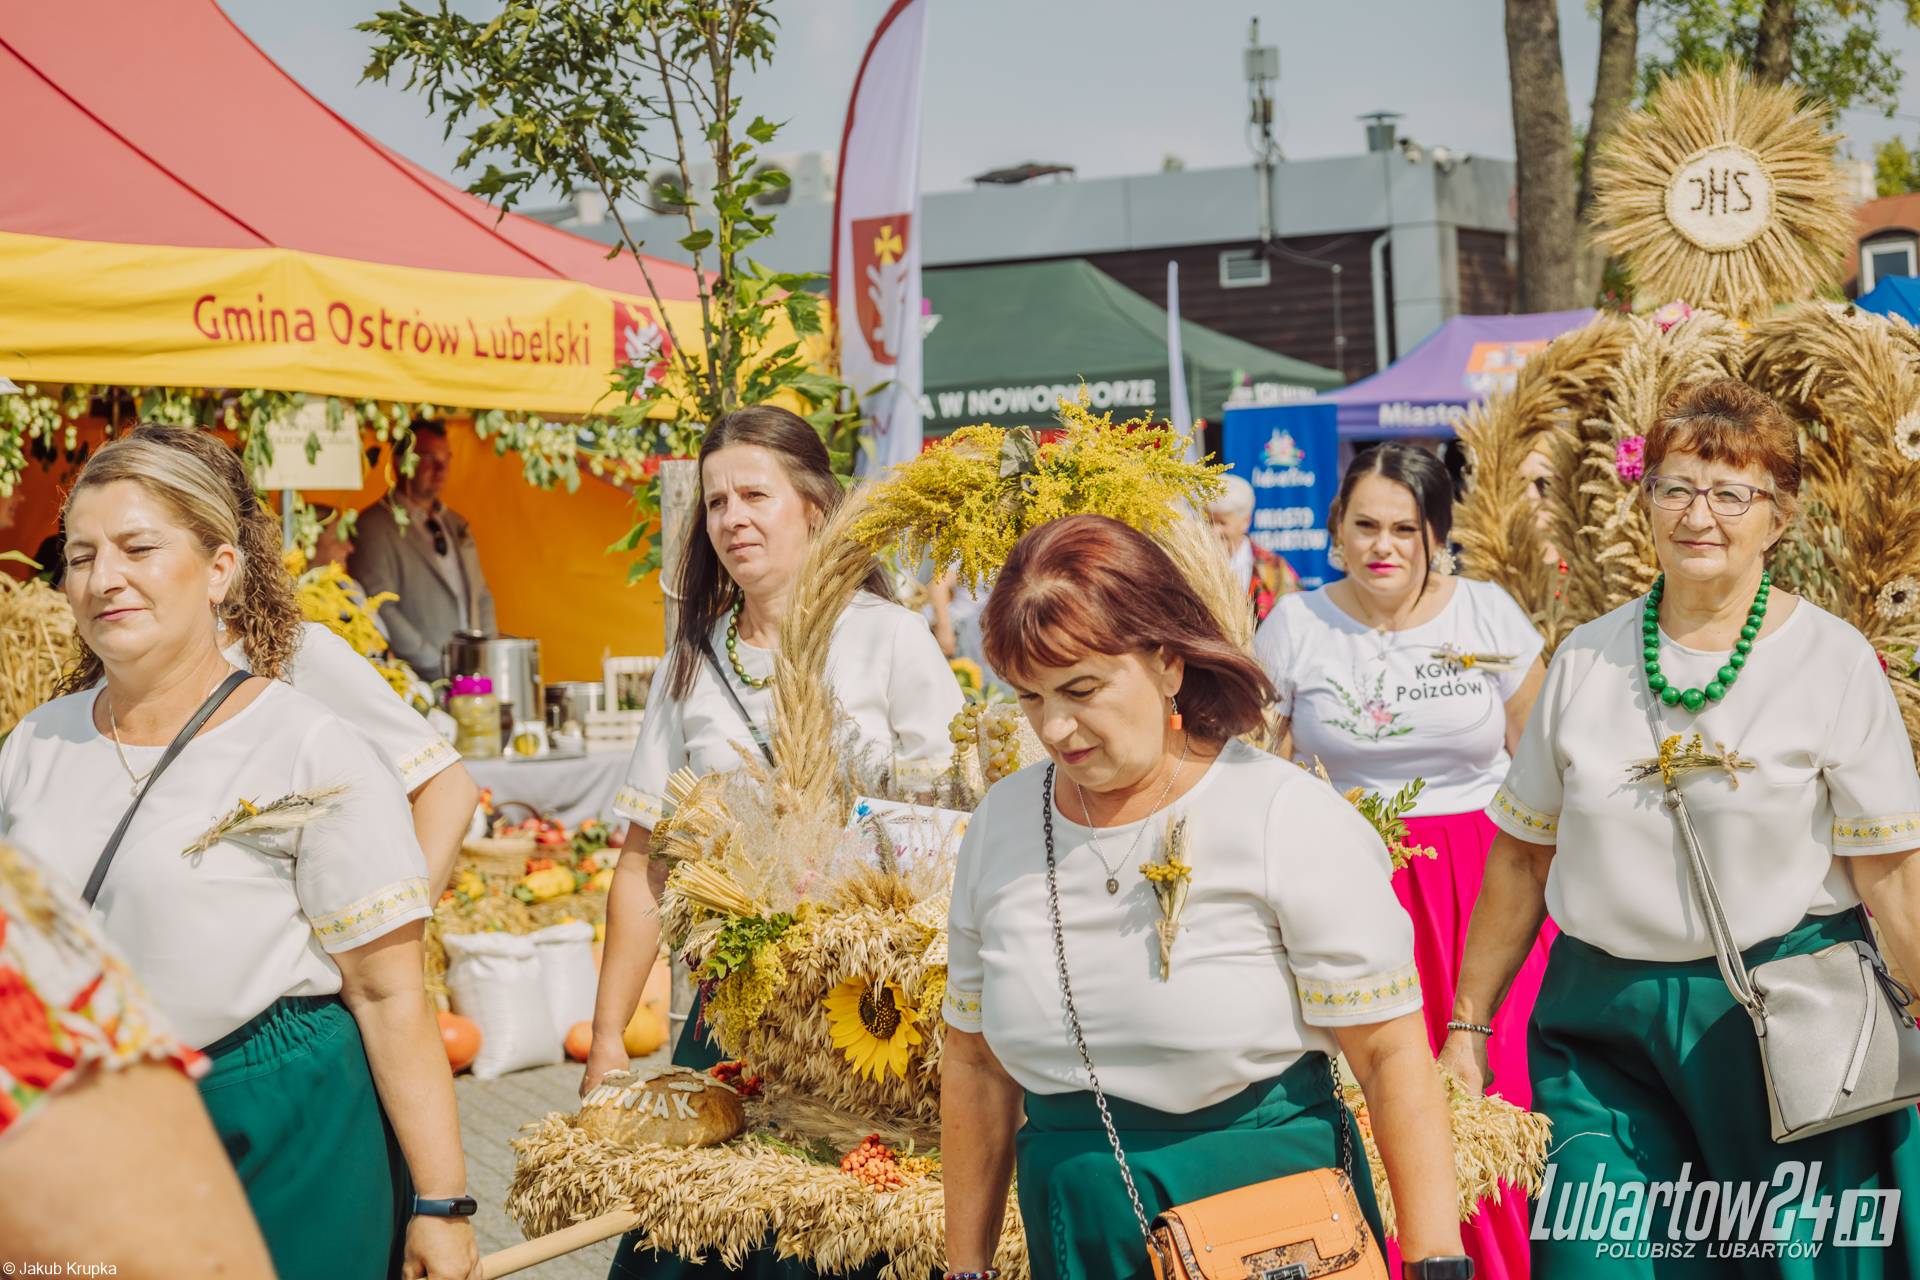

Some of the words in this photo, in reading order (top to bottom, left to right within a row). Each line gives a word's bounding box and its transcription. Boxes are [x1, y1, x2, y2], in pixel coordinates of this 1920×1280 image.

[193, 294, 315, 343] Gmina
[327, 301, 460, 356] Ostrów
[471, 317, 592, 366] Lubelski
[938, 391, 966, 419] W
[1415, 661, 1459, 680] KGW
[1396, 678, 1483, 701] Poizdów
